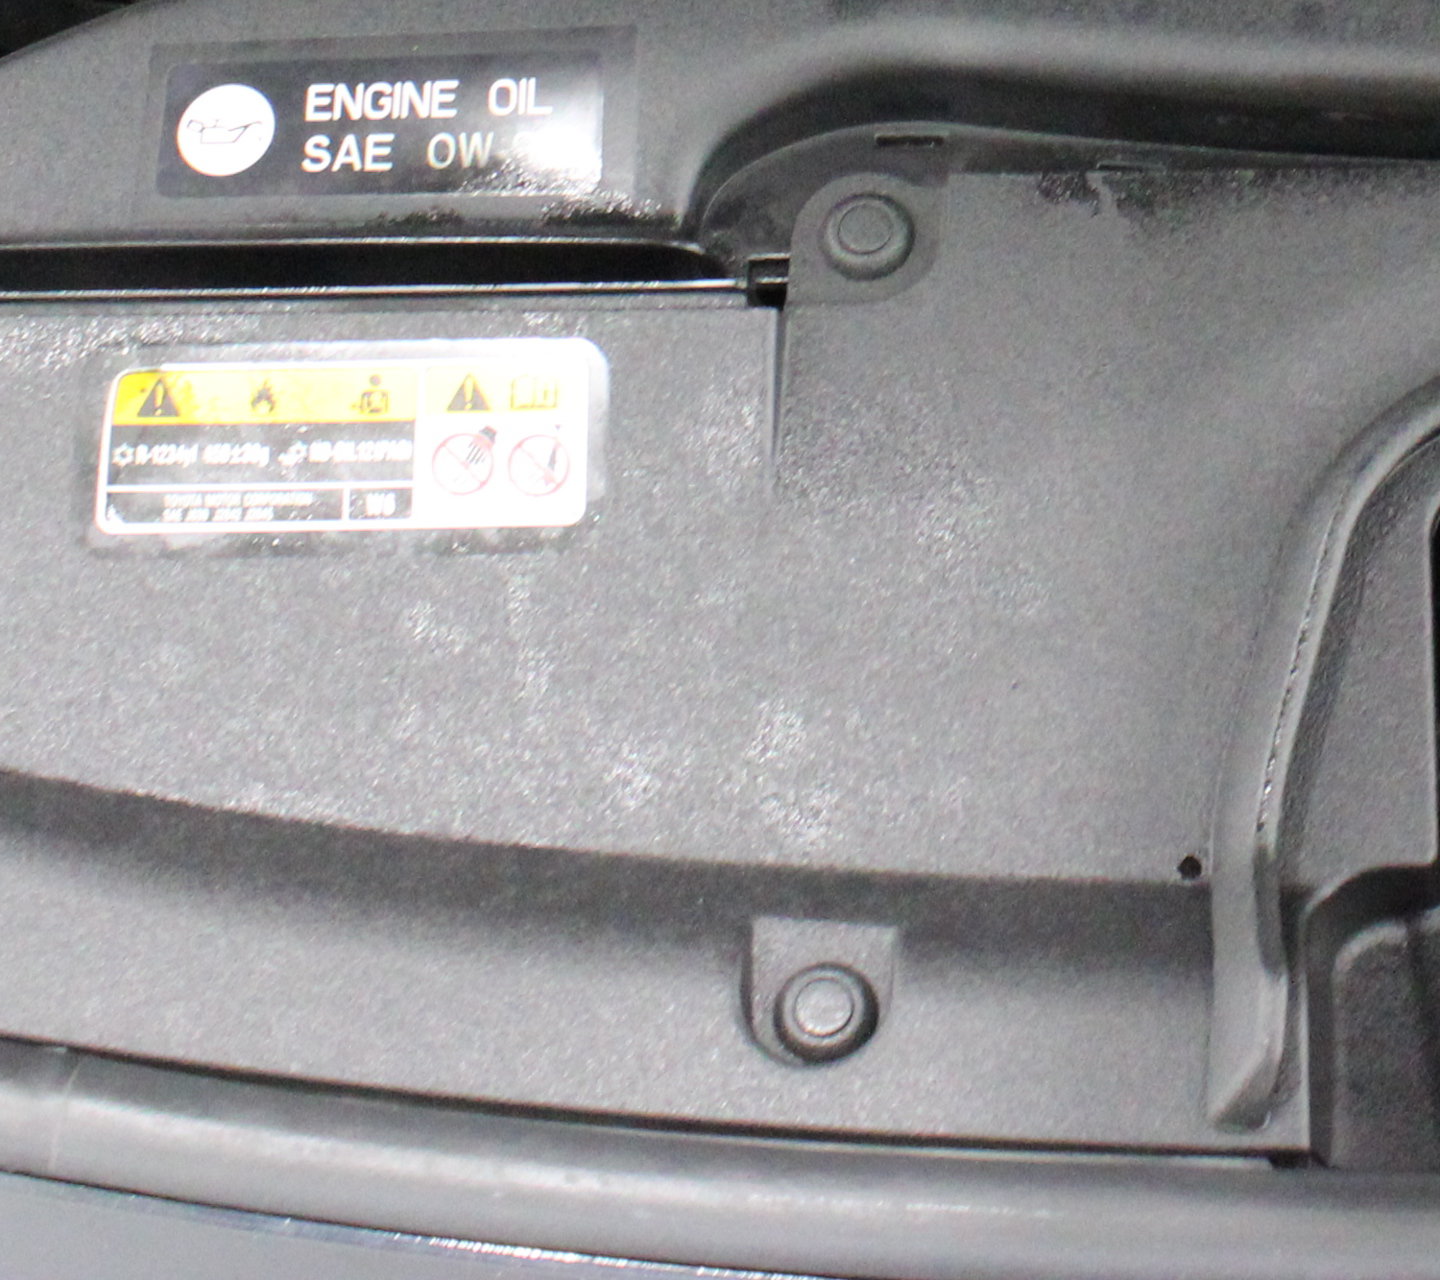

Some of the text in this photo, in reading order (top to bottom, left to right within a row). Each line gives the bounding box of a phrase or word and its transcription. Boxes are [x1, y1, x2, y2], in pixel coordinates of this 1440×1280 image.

[304, 77, 553, 122] ENGINE OIL
[300, 131, 394, 173] SAE
